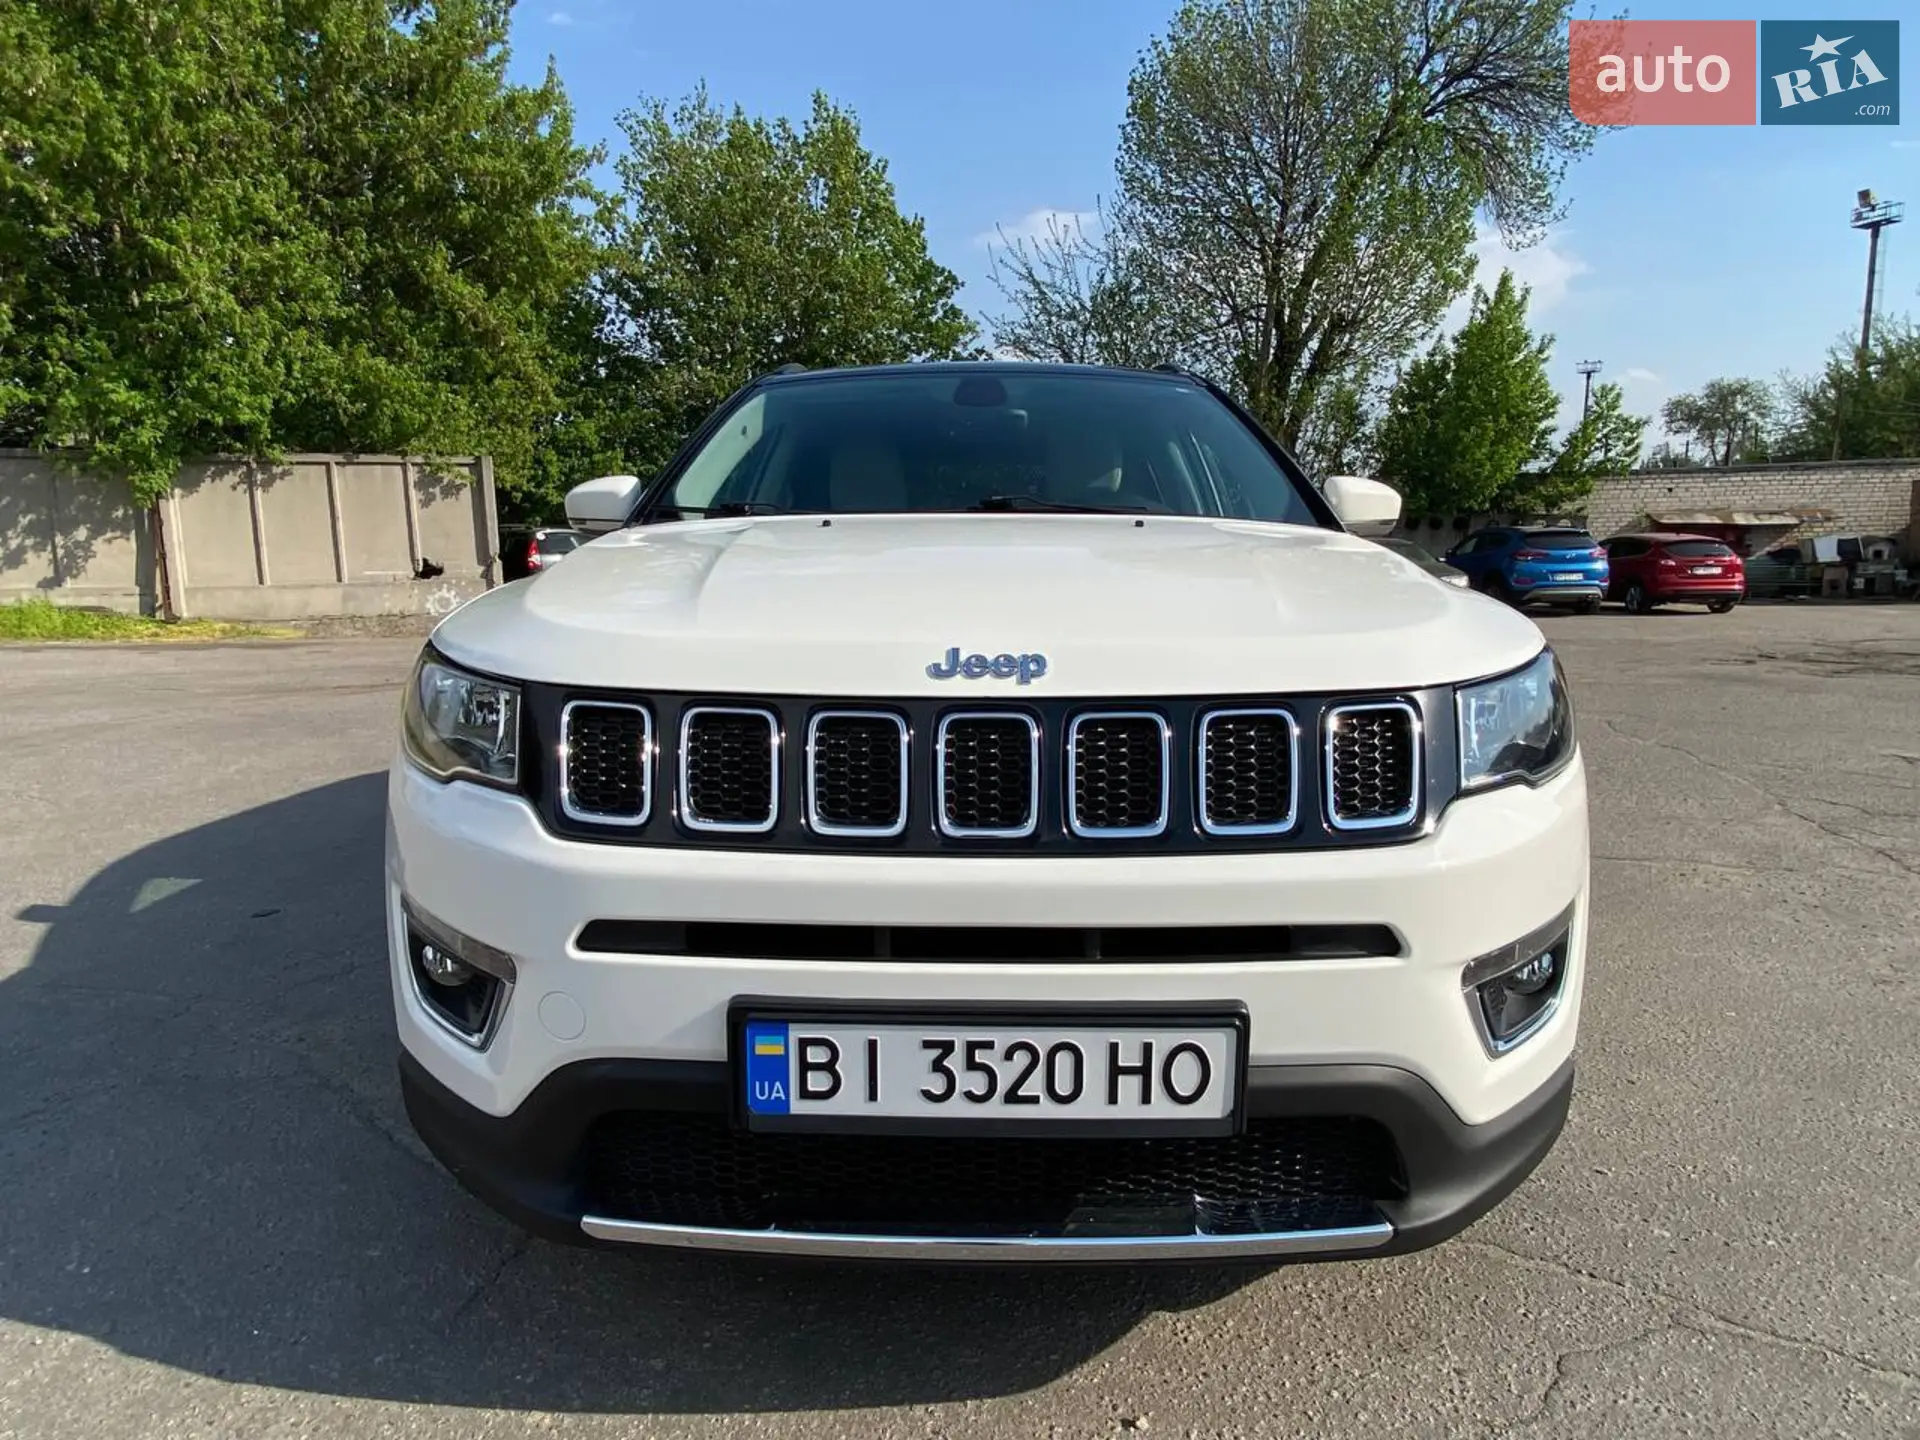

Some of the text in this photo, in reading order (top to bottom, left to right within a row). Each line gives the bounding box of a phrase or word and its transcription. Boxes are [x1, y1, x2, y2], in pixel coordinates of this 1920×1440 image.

[925, 647, 1047, 685] Jeep
[797, 1036, 1213, 1106] BI 3520 HO
[755, 1081, 786, 1101] UA
